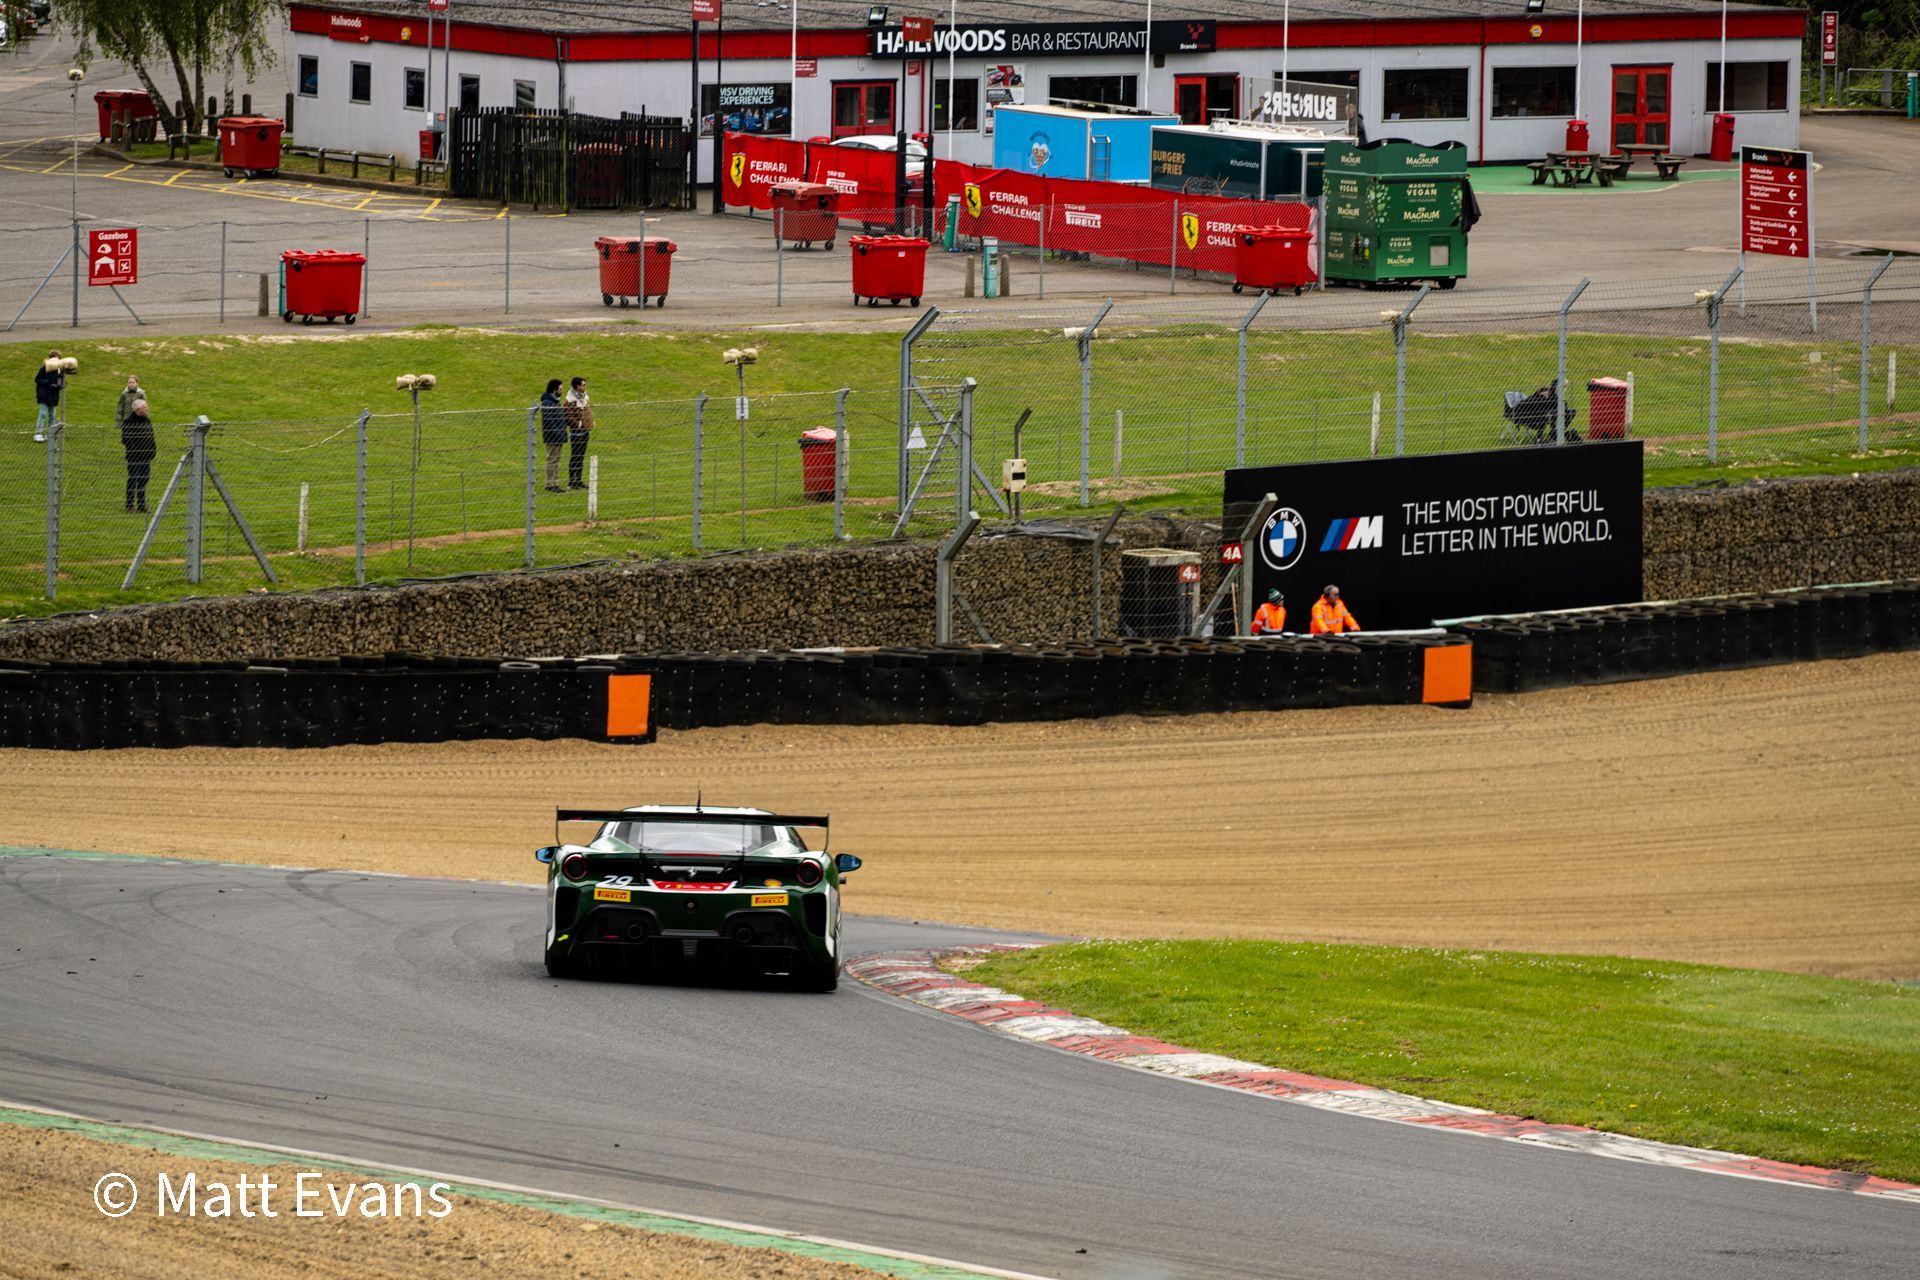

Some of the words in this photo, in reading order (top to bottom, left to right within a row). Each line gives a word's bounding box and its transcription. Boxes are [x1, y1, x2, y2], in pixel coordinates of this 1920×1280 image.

[331, 15, 362, 28] Hailwoods
[1011, 32, 1041, 51] BAR
[1042, 32, 1054, 51] &
[1056, 30, 1148, 50] RESTAURANT
[738, 86, 774, 96] DRIVING
[719, 95, 774, 106] EXPERIENCES
[1152, 149, 1186, 164] BURGERS
[1406, 156, 1440, 166] MAGNUM
[750, 160, 788, 173] FERRARI
[1162, 163, 1183, 175] FRIES
[1340, 185, 1358, 193] VEGAN
[1406, 188, 1438, 197] VEGAN
[989, 191, 1029, 206] FERRARI
[991, 204, 1042, 222] CHALLENGE
[1337, 206, 1360, 217] MAGNUM
[1403, 210, 1440, 221] MAGNUM
[1065, 210, 1102, 229] PIRELLI
[98, 231, 129, 241] Gazebos
[1206, 234, 1238, 248] CHALL
[1387, 256, 1415, 266] MAGNUM
[1401, 500, 1441, 526] THE
[1446, 496, 1500, 522] MOST
[1503, 489, 1605, 519] POWERFUL
[1267, 511, 1301, 530] BMW
[1402, 528, 1475, 556] LETTER
[1478, 526, 1498, 551] IN
[1501, 523, 1539, 548] THE
[1543, 518, 1613, 545] WORLD.
[1222, 545, 1242, 560] 4A
[596, 875, 634, 889] 29
